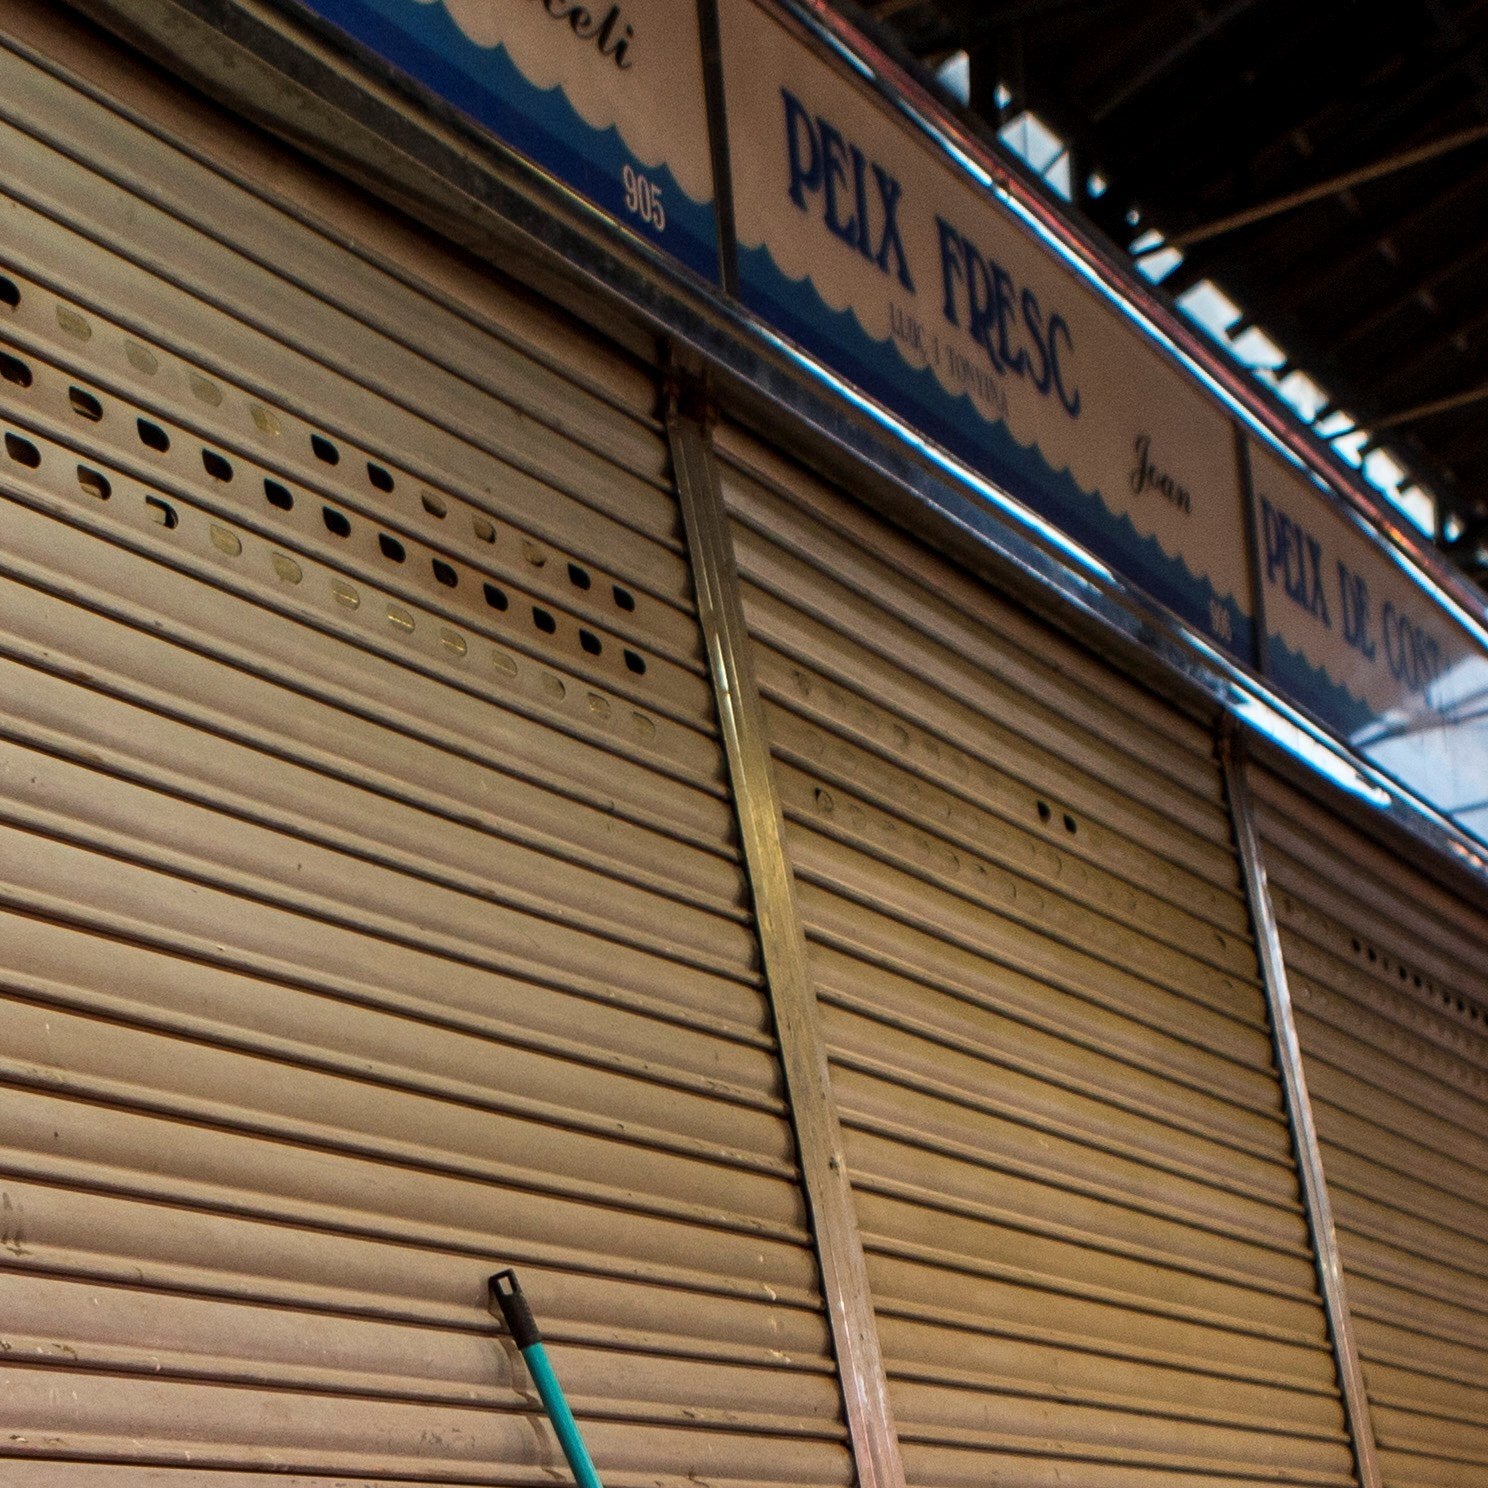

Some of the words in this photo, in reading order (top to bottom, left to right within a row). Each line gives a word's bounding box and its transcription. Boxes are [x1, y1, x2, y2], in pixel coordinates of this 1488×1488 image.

[622, 165, 666, 232] 905
[780, 85, 915, 296] PEIX
[935, 213, 1080, 418] FRESC
[1261, 495, 1333, 630] PEIX
[1337, 559, 1378, 662] DE
